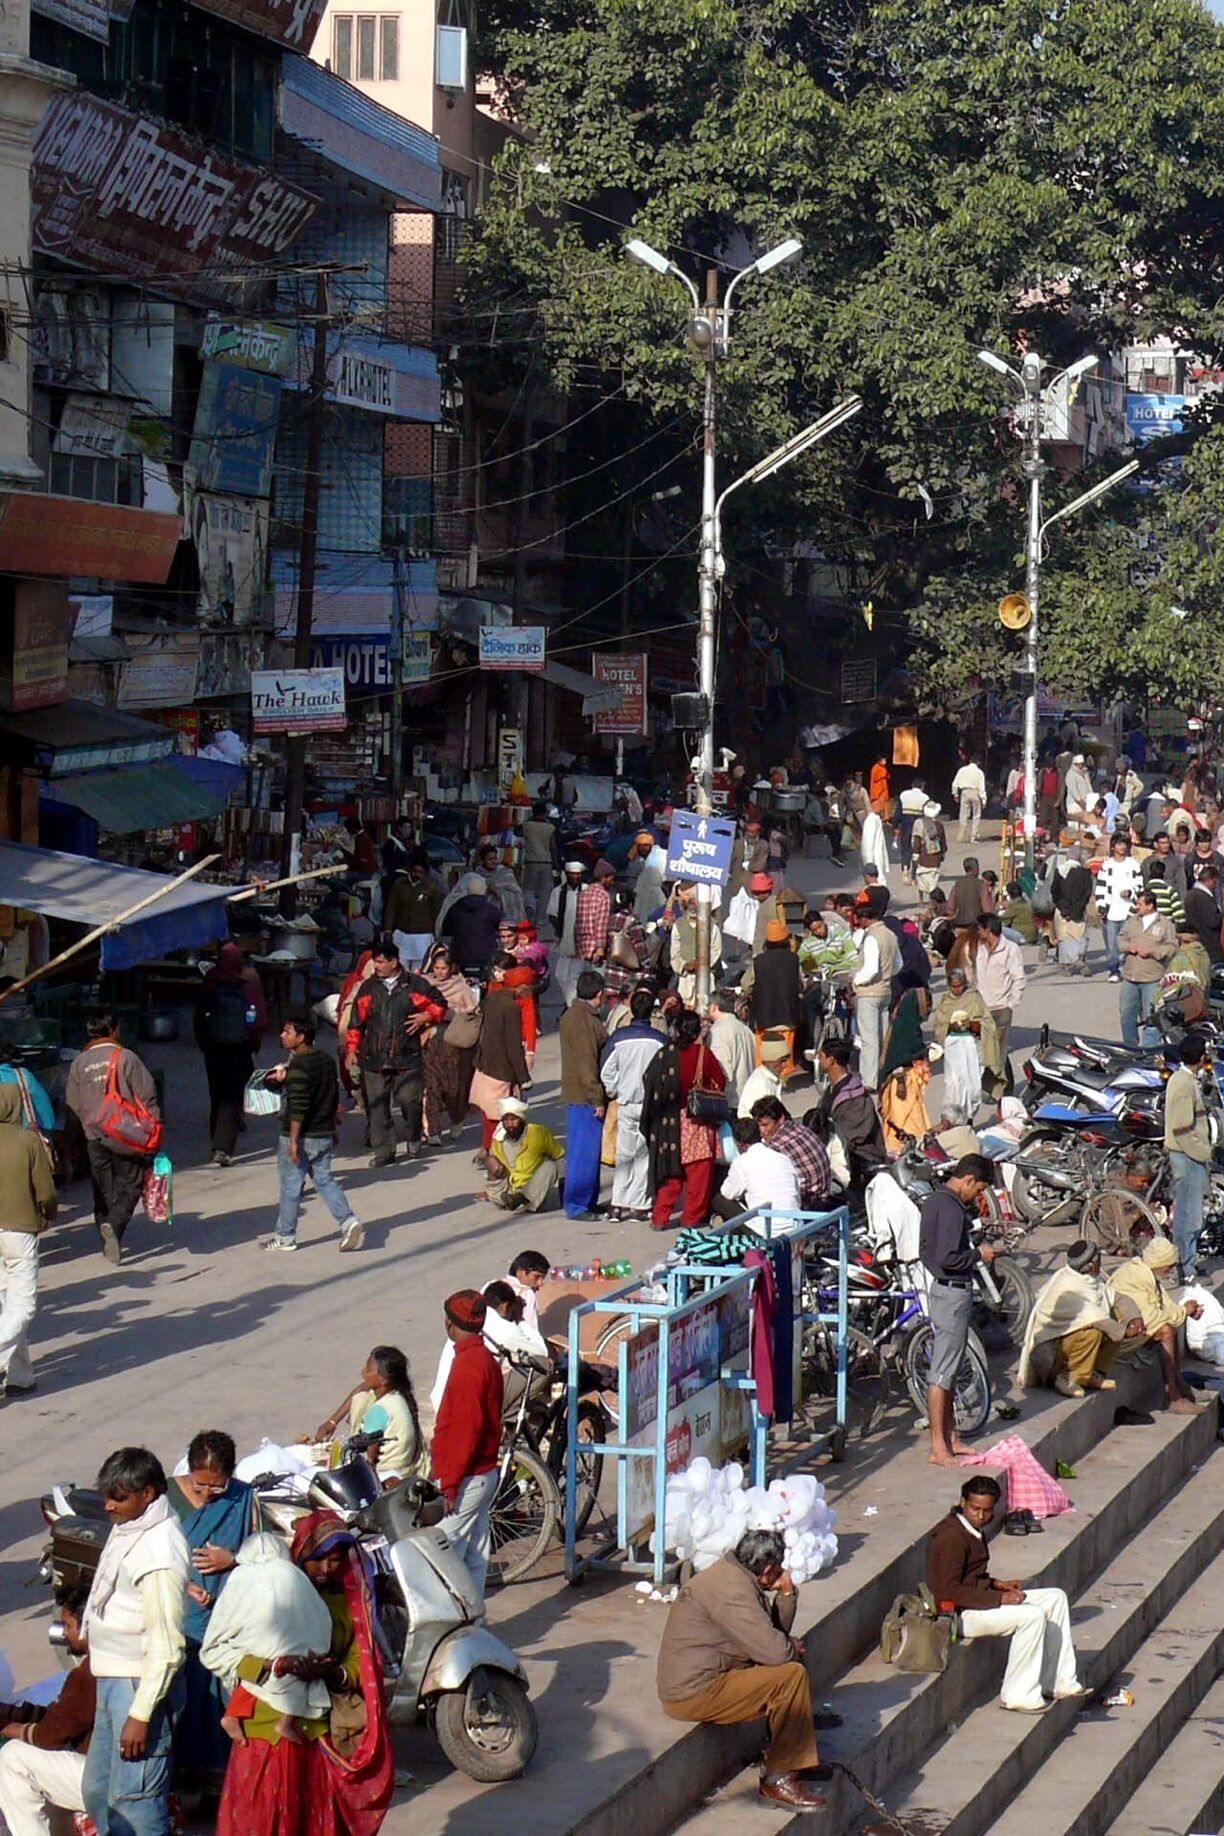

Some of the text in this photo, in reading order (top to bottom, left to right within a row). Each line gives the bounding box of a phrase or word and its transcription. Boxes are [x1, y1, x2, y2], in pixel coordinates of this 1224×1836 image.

[602, 669, 637, 681] HOTEL
[253, 690, 341, 708] The Hawk
